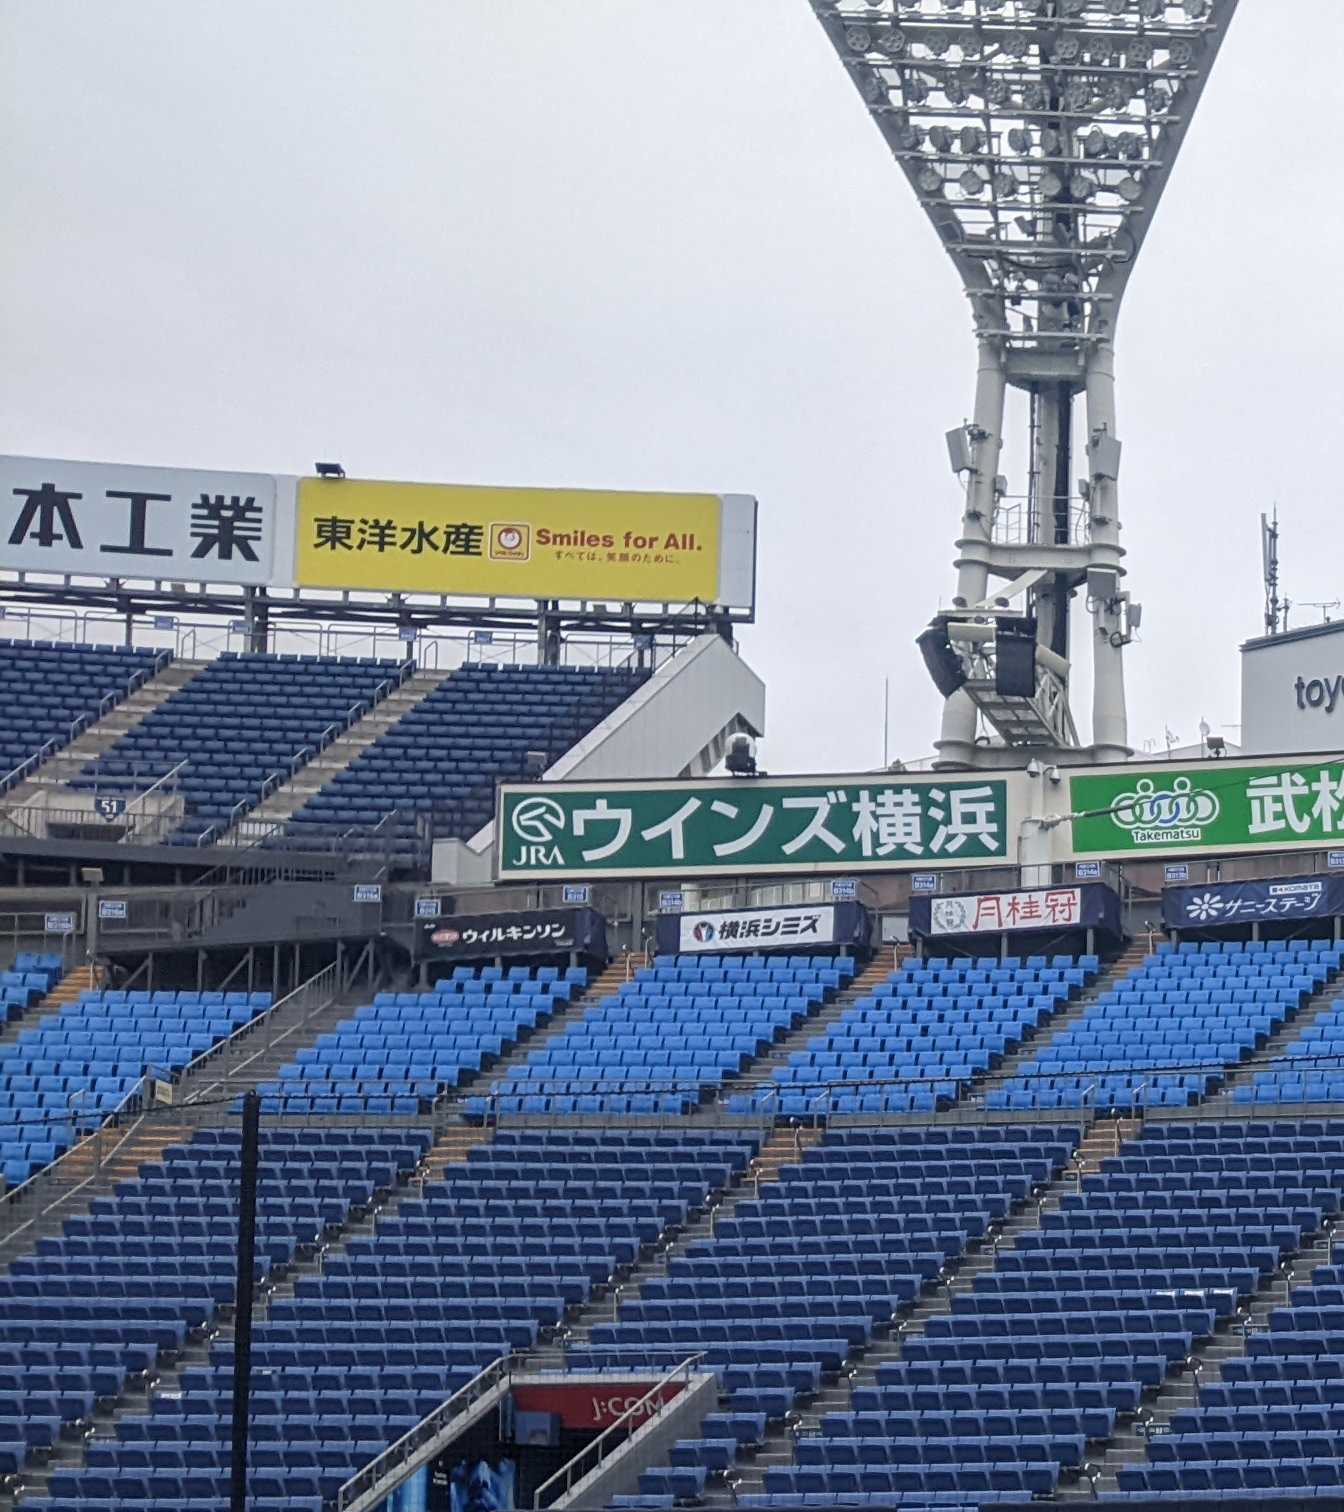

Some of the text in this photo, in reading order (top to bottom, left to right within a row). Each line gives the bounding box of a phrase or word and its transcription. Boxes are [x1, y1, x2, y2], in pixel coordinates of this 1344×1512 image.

[8, 483, 263, 562] 本工業
[313, 516, 484, 557] 東洋水産
[536, 528, 702, 551] Smiles for All.
[101, 799, 117, 813] 51
[572, 785, 1000, 862] ウインズ横浜
[1133, 828, 1200, 843] Takematsu
[512, 845, 566, 866] JRA
[972, 890, 1077, 930] 月桂冠
[1225, 893, 1322, 917] サニーステージ
[462, 923, 566, 944] ウィルキンソン
[719, 914, 821, 940] 横浜シミズ
[592, 1391, 664, 1421] J:COM
